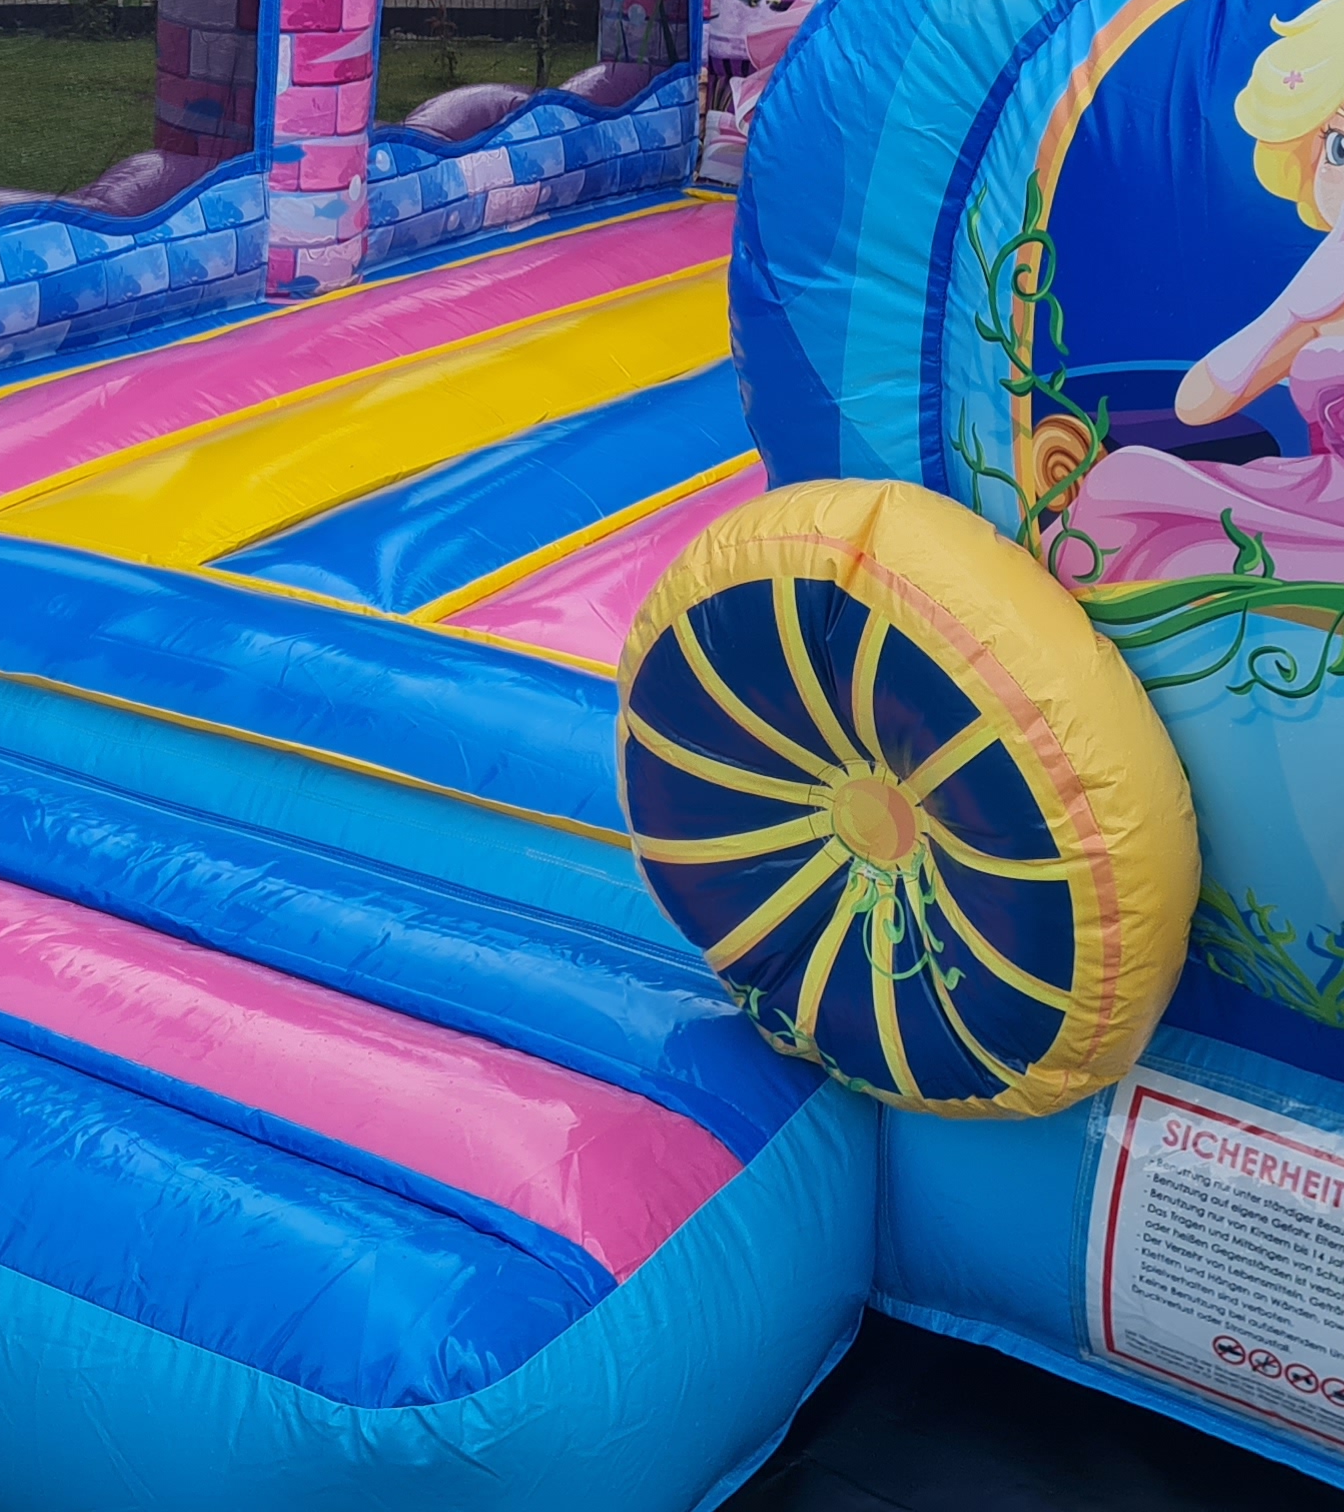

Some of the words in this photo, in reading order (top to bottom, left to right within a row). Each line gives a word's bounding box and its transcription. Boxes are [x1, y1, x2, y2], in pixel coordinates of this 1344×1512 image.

[1152, 1172, 1209, 1203] Benutzung
[1210, 1196, 1230, 1208] auf
[1230, 1204, 1269, 1224] eigene
[1233, 1188, 1262, 1204] unter
[1263, 1199, 1316, 1225] ständiger
[1147, 1203, 1168, 1219] Das
[1170, 1210, 1206, 1233] Tragen
[1208, 1227, 1230, 1242] und
[1292, 1259, 1314, 1274] von
[1149, 1187, 1206, 1218] Benutzung
[1207, 1211, 1226, 1223] nur
[1227, 1218, 1248, 1233] von
[1249, 1226, 1292, 1250] Kindern
[1293, 1242, 1310, 1256] bis
[1312, 1248, 1325, 1262] 14
[1141, 1246, 1182, 1270] Klettern
[1183, 1264, 1206, 1279] und
[1207, 1272, 1251, 1296] Hängen
[1252, 1291, 1268, 1303] an
[1142, 1232, 1163, 1246] Der
[1164, 1239, 1204, 1262] Verzehr
[1205, 1257, 1226, 1272] von
[1144, 1220, 1171, 1235] oder
[1172, 1227, 1209, 1250] heißen
[1294, 1274, 1307, 1287] ist
[1170, 1286, 1226, 1317] Benutzung
[1228, 1309, 1246, 1323] bei
[1196, 1312, 1223, 1326] oder
[1217, 1292, 1239, 1306] sind
